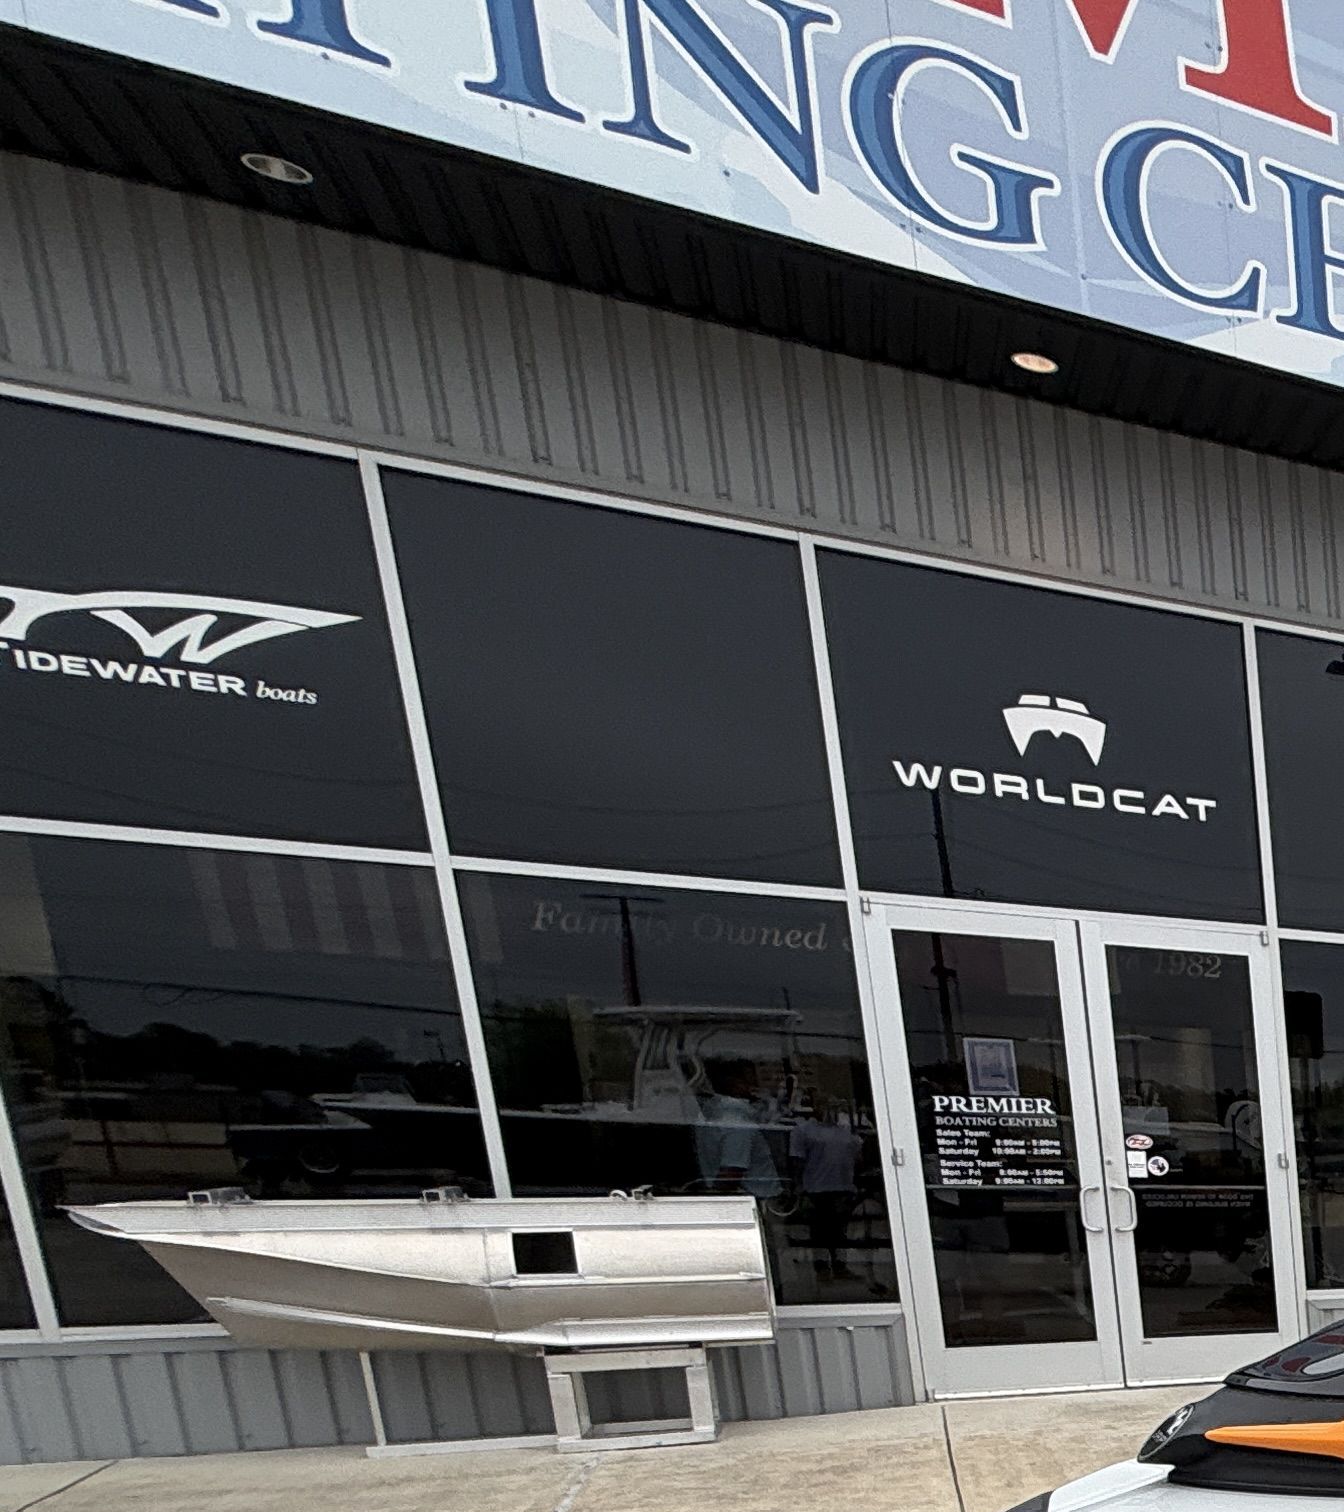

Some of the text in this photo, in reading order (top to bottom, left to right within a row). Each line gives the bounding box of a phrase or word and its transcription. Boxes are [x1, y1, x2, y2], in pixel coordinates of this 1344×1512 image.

[0, 641, 318, 705] IDEWATER boats
[892, 760, 1217, 822] WORLDCAT
[932, 1095, 1056, 1115] PREMIER
[935, 1116, 1058, 1127] BOATING CENTERS
